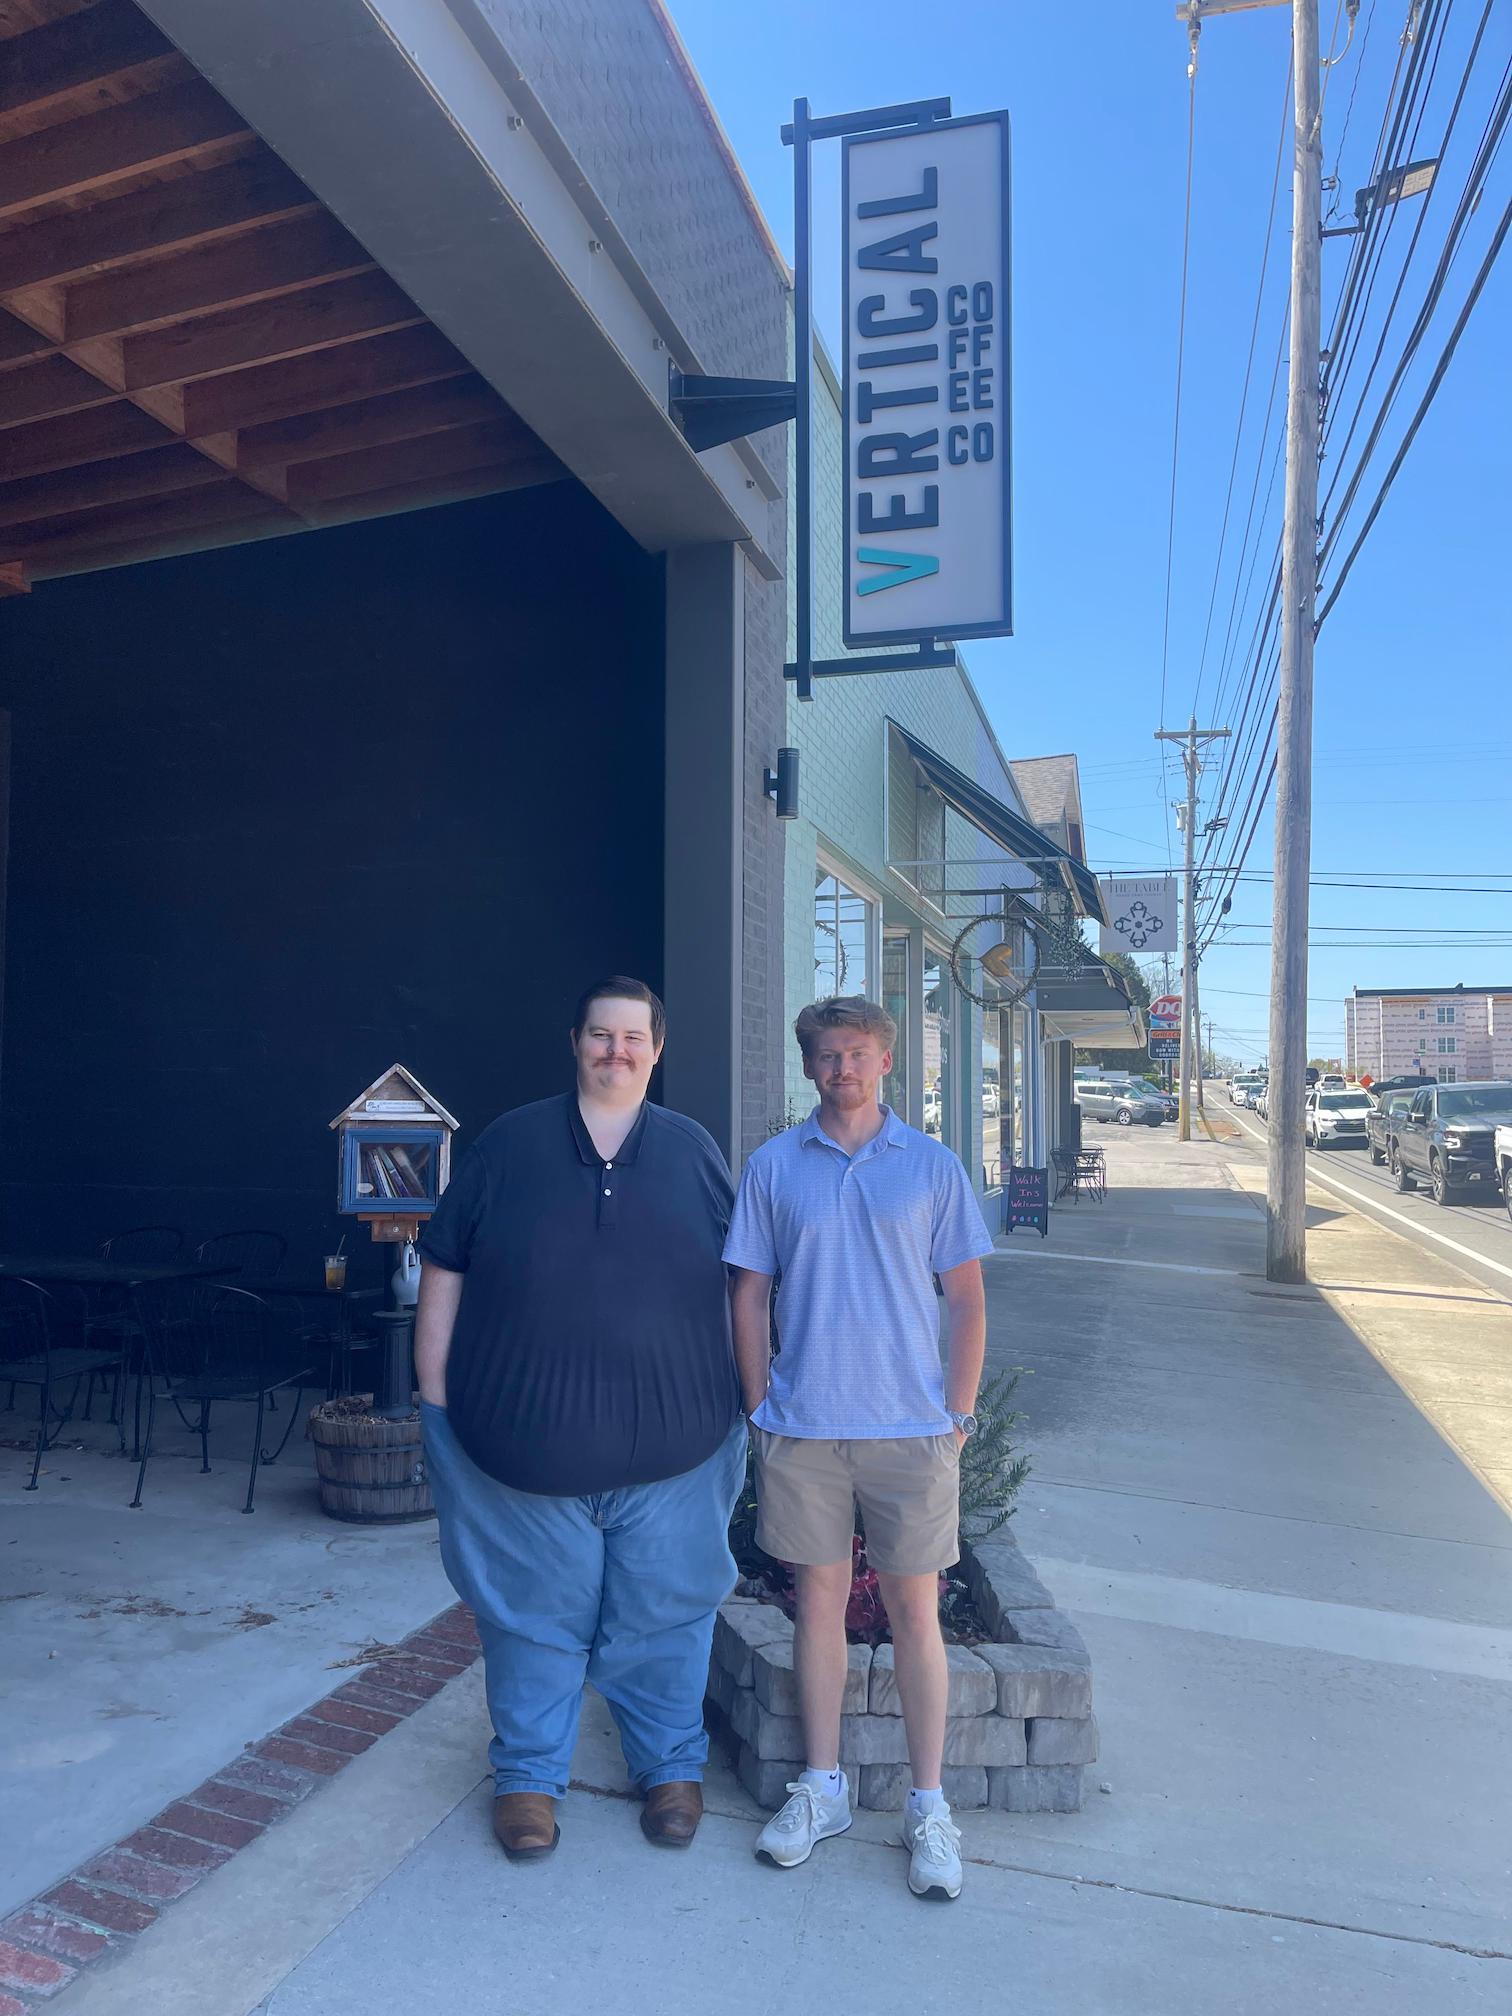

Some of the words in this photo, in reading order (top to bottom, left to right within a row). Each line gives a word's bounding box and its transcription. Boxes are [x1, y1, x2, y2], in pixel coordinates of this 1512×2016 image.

[857, 165, 940, 597] VERTICAL
[947, 421, 994, 466] CO
[1109, 883, 1130, 893] THE
[1014, 1174, 1041, 1185] Walk
